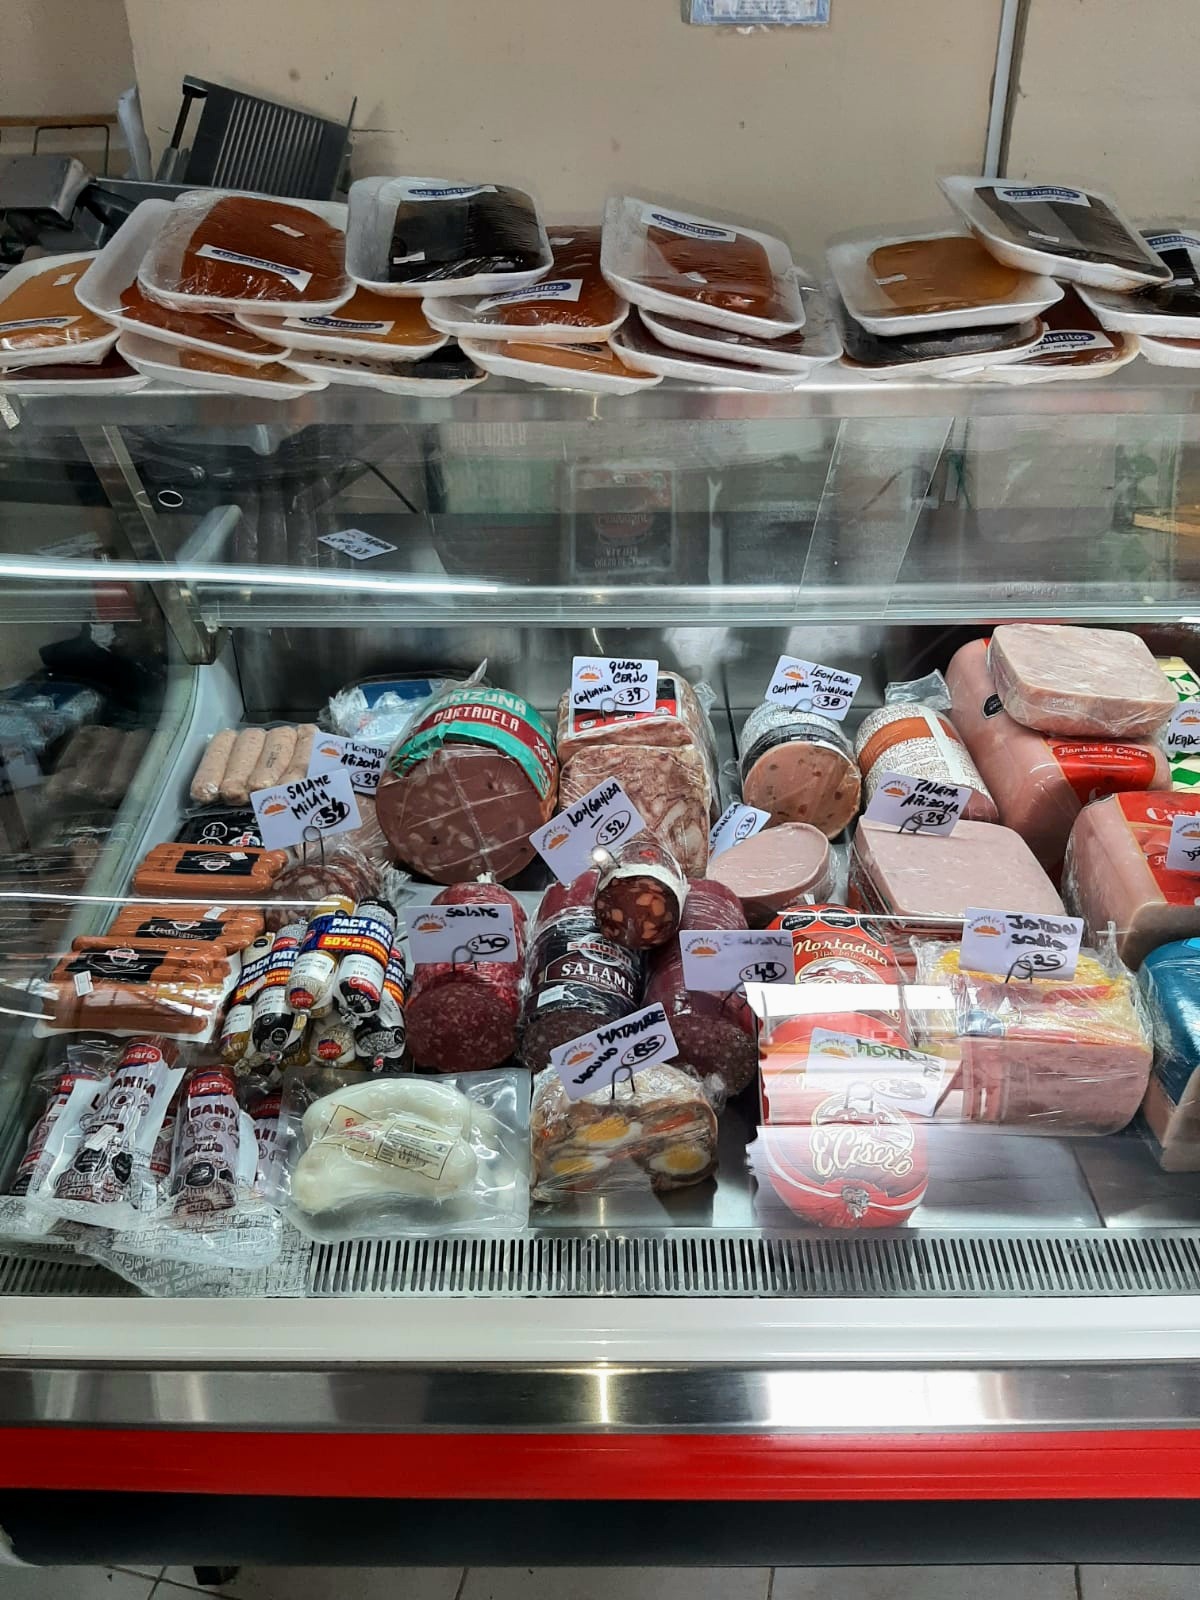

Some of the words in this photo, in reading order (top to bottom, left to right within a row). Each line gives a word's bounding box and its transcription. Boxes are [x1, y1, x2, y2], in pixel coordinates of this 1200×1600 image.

[1040, 333, 1089, 344] nietitos
[433, 706, 520, 732] MORTADELA
[332, 917, 368, 928] PACK
[323, 936, 352, 946] 50%
[243, 955, 270, 977] PACK
[561, 962, 635, 999] SALAME
